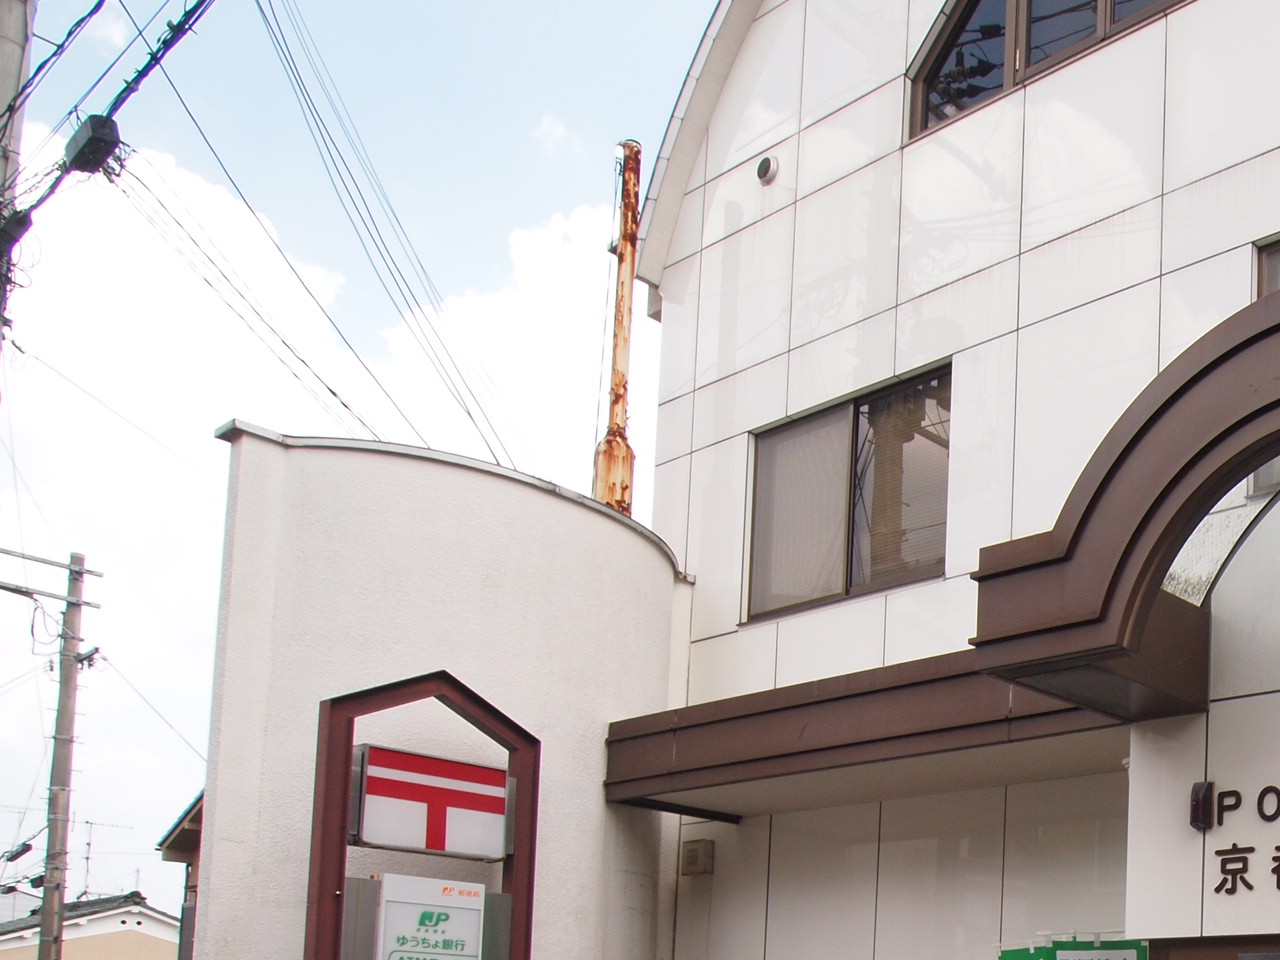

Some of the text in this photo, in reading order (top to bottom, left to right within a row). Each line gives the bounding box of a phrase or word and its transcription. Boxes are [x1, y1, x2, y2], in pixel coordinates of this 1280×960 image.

[396, 935, 466, 951] ゆうちょ銀行
